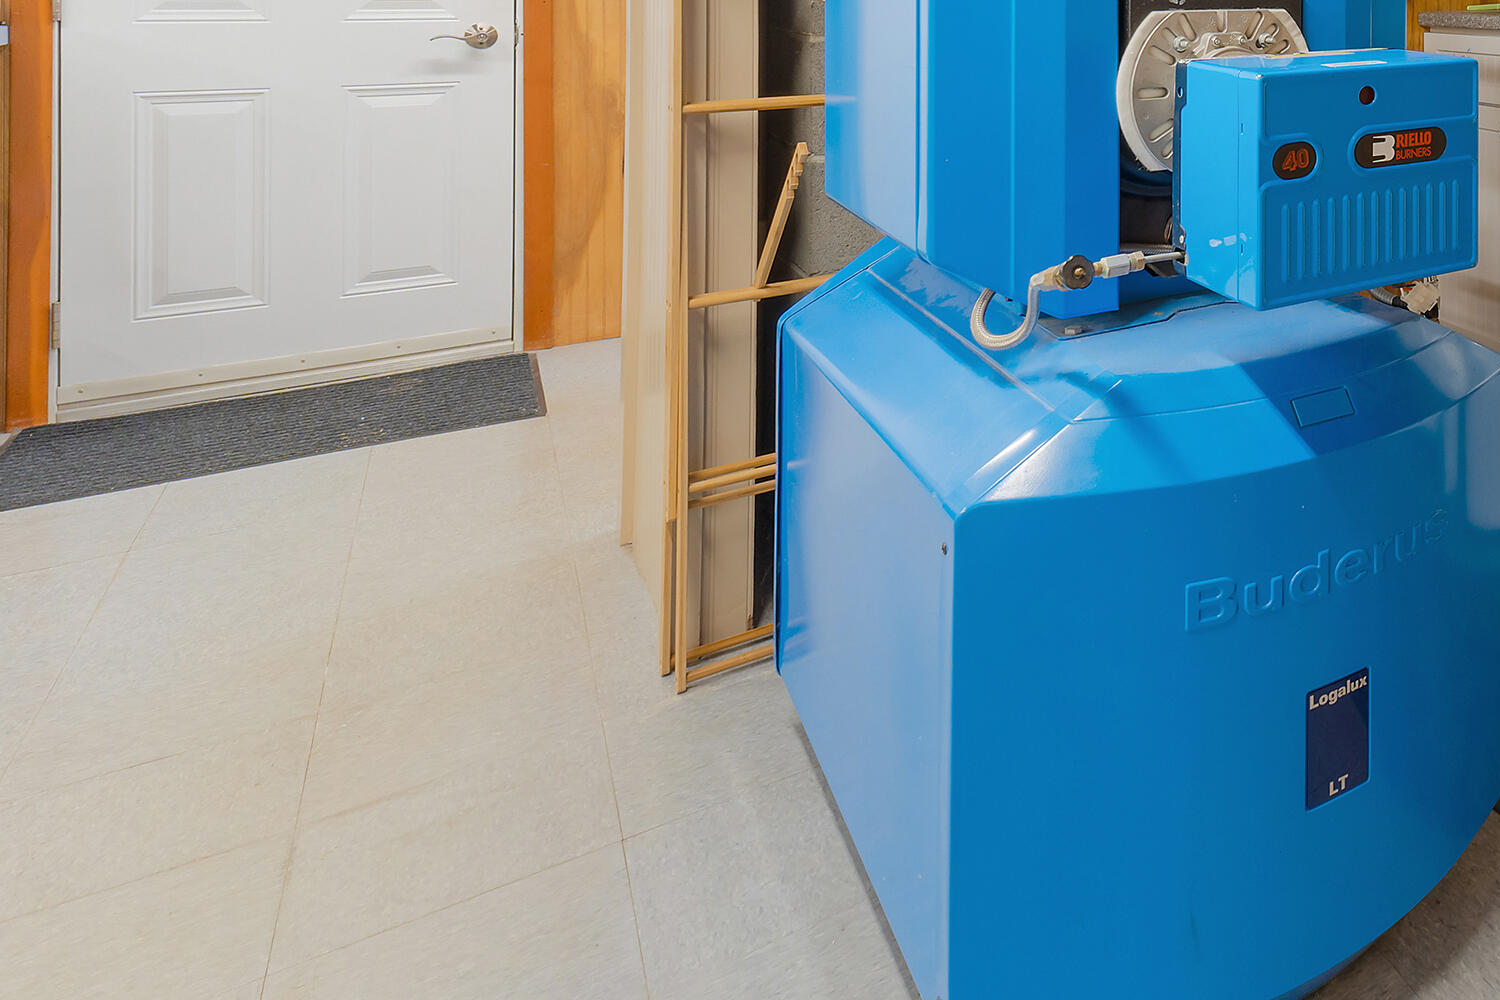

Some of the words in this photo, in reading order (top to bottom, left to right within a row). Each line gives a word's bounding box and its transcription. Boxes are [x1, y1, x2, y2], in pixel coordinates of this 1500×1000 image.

[1396, 131, 1432, 148] RIELLO
[1282, 148, 1310, 172] 40
[1396, 146, 1432, 161] BURNERS
[1185, 508, 1448, 632] Buderus
[1309, 674, 1368, 711] Logalux
[1328, 774, 1349, 797] LT
